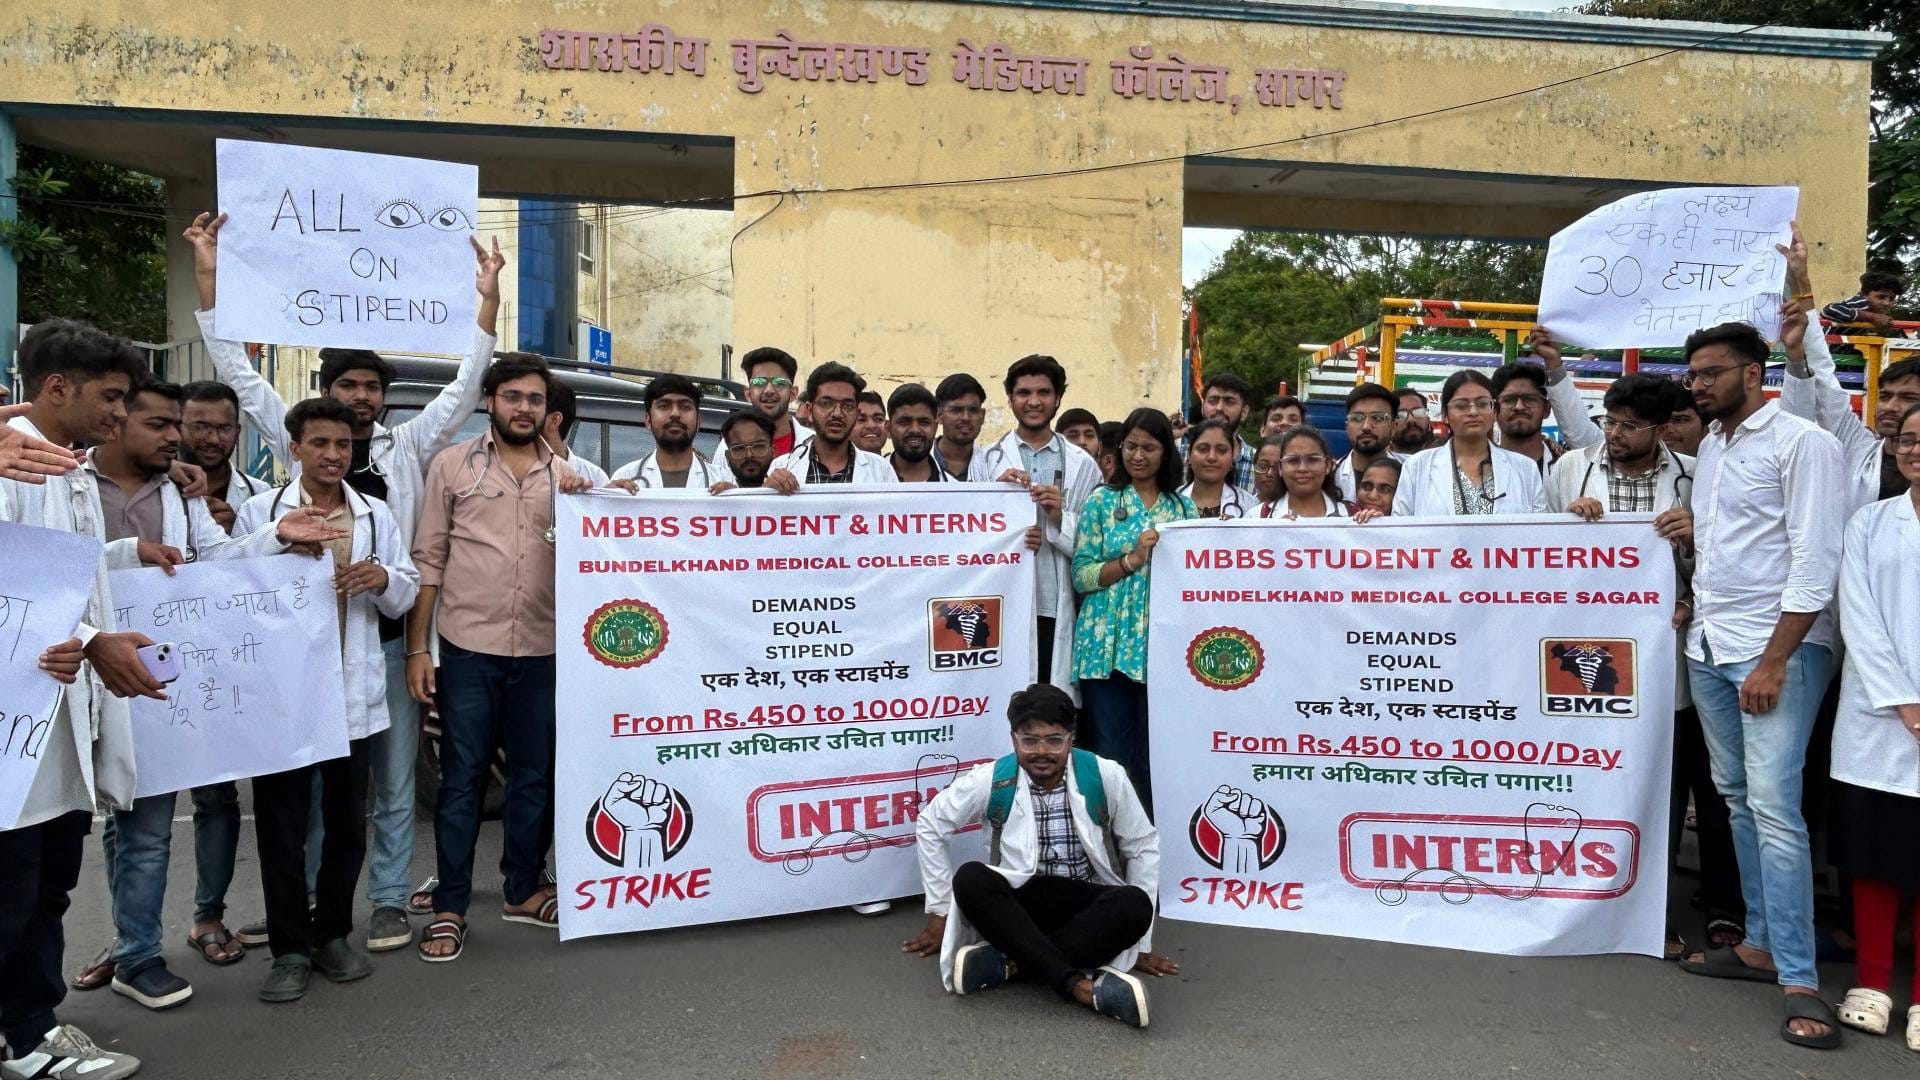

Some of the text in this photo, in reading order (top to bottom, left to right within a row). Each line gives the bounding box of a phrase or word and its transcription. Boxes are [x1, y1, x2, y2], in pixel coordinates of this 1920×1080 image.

[540, 24, 709, 77] शासकीय
[953, 38, 1089, 96] मेडिकल
[1110, 45, 1241, 115] कॉलेज,
[1255, 67, 1347, 109] सागर
[271, 187, 361, 234] ALL
[350, 247, 397, 282] ON
[1574, 255, 1643, 298] 30
[1662, 261, 1743, 291] हजार
[1634, 298, 1712, 332] वेतन
[582, 511, 1008, 538] MBBS STUDENT & INTERNS
[578, 551, 1021, 573] BUNDELKHAND MEDICAL COLLEGE SAGAR
[1185, 547, 1640, 569] MBBS STUDENT & INTERNS
[153, 597, 206, 627] हमारा
[292, 576, 310, 610] है
[751, 596, 857, 613] DEMANDS
[1182, 590, 1660, 605] BUNDELKHAND MEDICAL COLLEGE SAGAR
[772, 620, 842, 637] EQUAL
[1346, 631, 1457, 646] DEMANDS
[232, 633, 263, 663] भी
[765, 642, 854, 660] STIPEND
[935, 649, 998, 669] BMC
[1367, 654, 1441, 671] EQUAL
[701, 660, 909, 692] एक देश, एक स्टाइपेंड
[1360, 677, 1454, 693] STIPEND
[199, 678, 222, 711] है
[1296, 698, 1517, 721] एक देश, एक स्टाइपेंड
[1547, 697, 1633, 715] BMC
[612, 695, 990, 734] From Rs.450 to 1000/Day
[656, 724, 955, 763] हमारा अधिकार उचित पगार!!
[1212, 731, 1622, 768] From Rs.450 to 1000/Day
[1252, 763, 1573, 793] हमारा अधिकार उचित पगार!!
[1372, 833, 1618, 878] INTERNS
[575, 867, 712, 911] STRIKE
[1179, 877, 1303, 911] STRIKE
